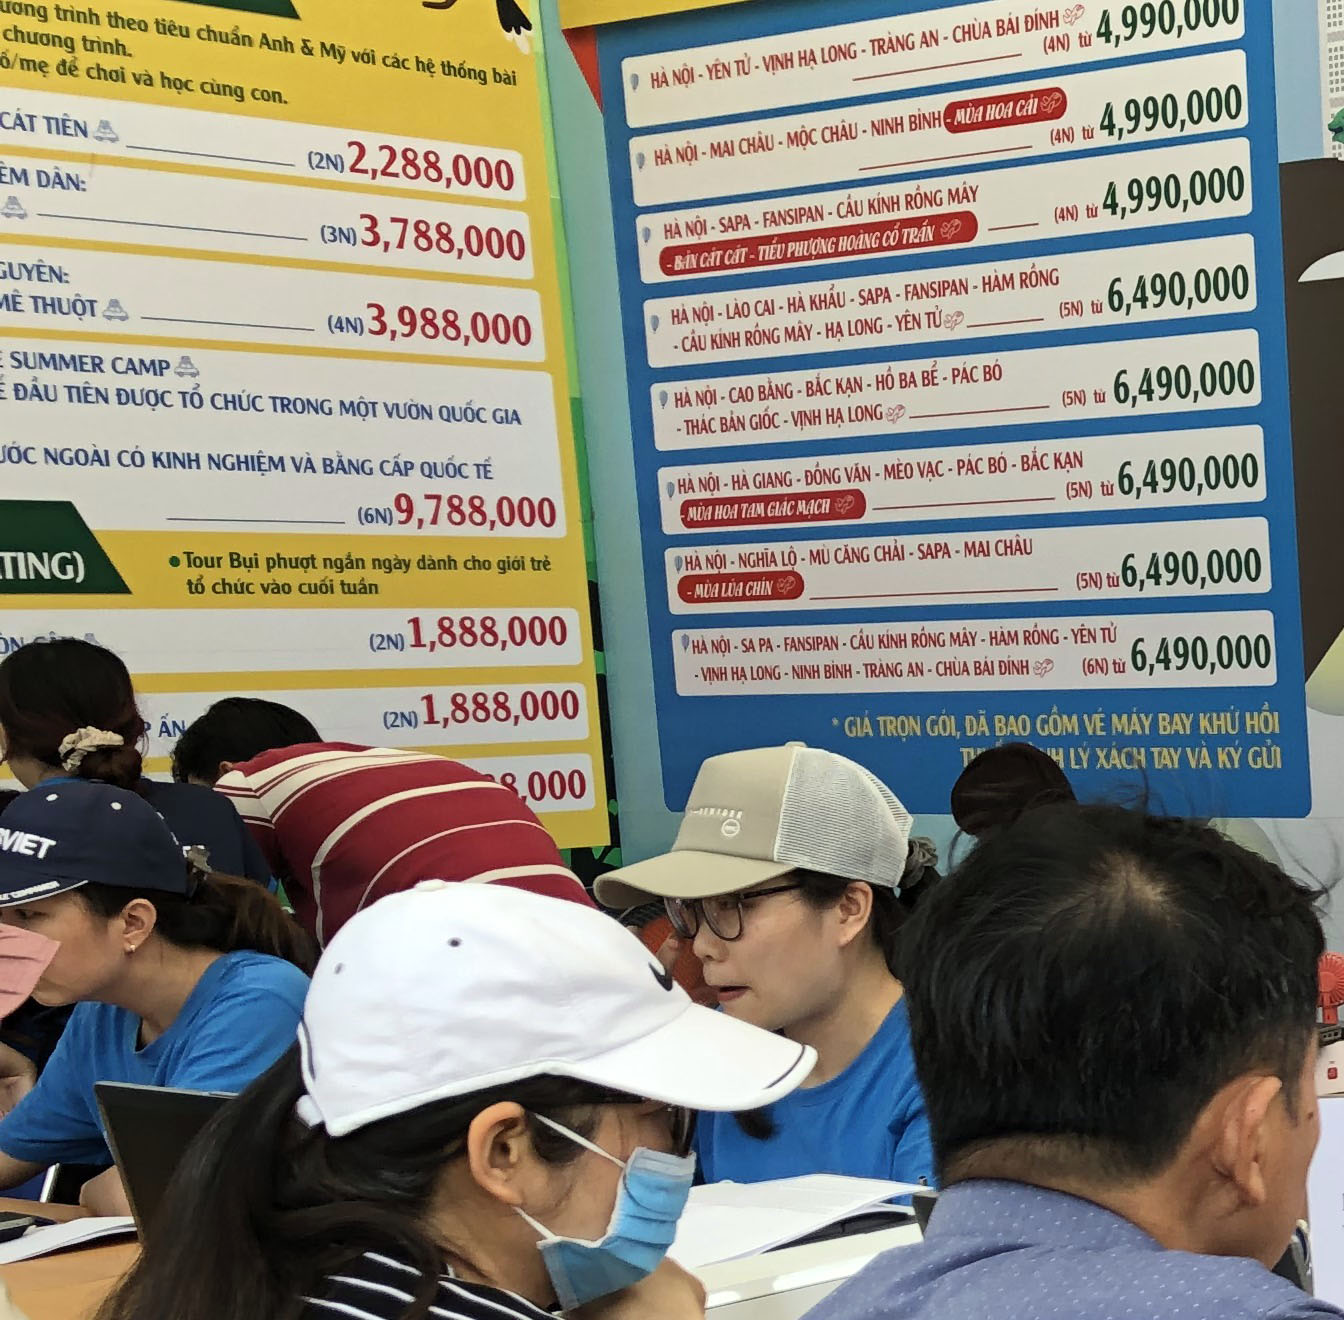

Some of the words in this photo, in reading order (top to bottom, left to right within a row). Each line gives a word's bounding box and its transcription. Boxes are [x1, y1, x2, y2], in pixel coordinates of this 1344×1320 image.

[54, 4, 100, 25] trình
[106, 12, 148, 32] theo
[154, 18, 190, 38] tiêu
[197, 24, 252, 47] chuẩn
[260, 33, 294, 53] Anh
[301, 39, 314, 56] &
[320, 42, 346, 64] Mỹ
[351, 49, 376, 65] với
[382, 54, 410, 70] các
[415, 56, 436, 78] hệ
[440, 60, 487, 85] thống
[492, 68, 516, 86] bài
[1100, 84, 1245, 140] 4,990,000
[309, 150, 345, 174] (2N)
[347, 140, 515, 192] 2,288,000
[320, 225, 357, 247] (3N)
[359, 213, 526, 262] 3,788,000
[10, 351, 105, 373] SUMMER
[112, 357, 170, 376] CAMP
[678, 478, 695, 494] HÀ
[698, 472, 720, 496] NỘI
[732, 474, 750, 490] HÀ
[753, 471, 792, 489] GIANG
[805, 464, 841, 486] ĐỒNG
[844, 463, 870, 483] VĂN
[884, 463, 913, 480] MÈO
[917, 460, 944, 482] VẠC
[957, 454, 984, 476] PÁC
[988, 452, 1007, 474] BÓ
[1021, 451, 1049, 472] BẮC
[1054, 451, 1083, 472] KẠN
[1066, 480, 1093, 500] (5N)
[1100, 480, 1114, 497] từ
[1118, 453, 1258, 499] 6,490,000
[358, 507, 393, 527] (6N)
[394, 492, 557, 531] 9,788,000
[0, 551, 85, 583] TING)
[183, 552, 223, 568] Tour
[229, 552, 259, 572] Bụi
[266, 553, 317, 573] phượt
[323, 552, 365, 573] ngắn
[372, 555, 411, 574] ngày
[417, 555, 457, 570] dành
[464, 555, 491, 570] cho
[497, 556, 525, 574] giới
[530, 556, 551, 571] trẻ
[187, 575, 205, 594] tổ
[212, 578, 255, 594] chức
[260, 580, 292, 594] vào
[298, 579, 334, 594] cuối
[340, 578, 378, 594] tuần
[370, 634, 404, 652] (2N)
[408, 616, 567, 652] 1,888,000
[845, 717, 873, 737] GIÁ
[877, 716, 920, 741] TRỌN
[926, 716, 960, 738] GÓI,
[966, 710, 989, 736] ĐÃ
[994, 715, 1030, 736] BAO
[1036, 709, 1079, 736] GỒM
[1083, 708, 1106, 735] VÉ
[1112, 708, 1152, 734] MÁY
[1158, 713, 1193, 734] BAY
[1200, 706, 1239, 734] KHỨ
[1246, 705, 1279, 734] HỒI
